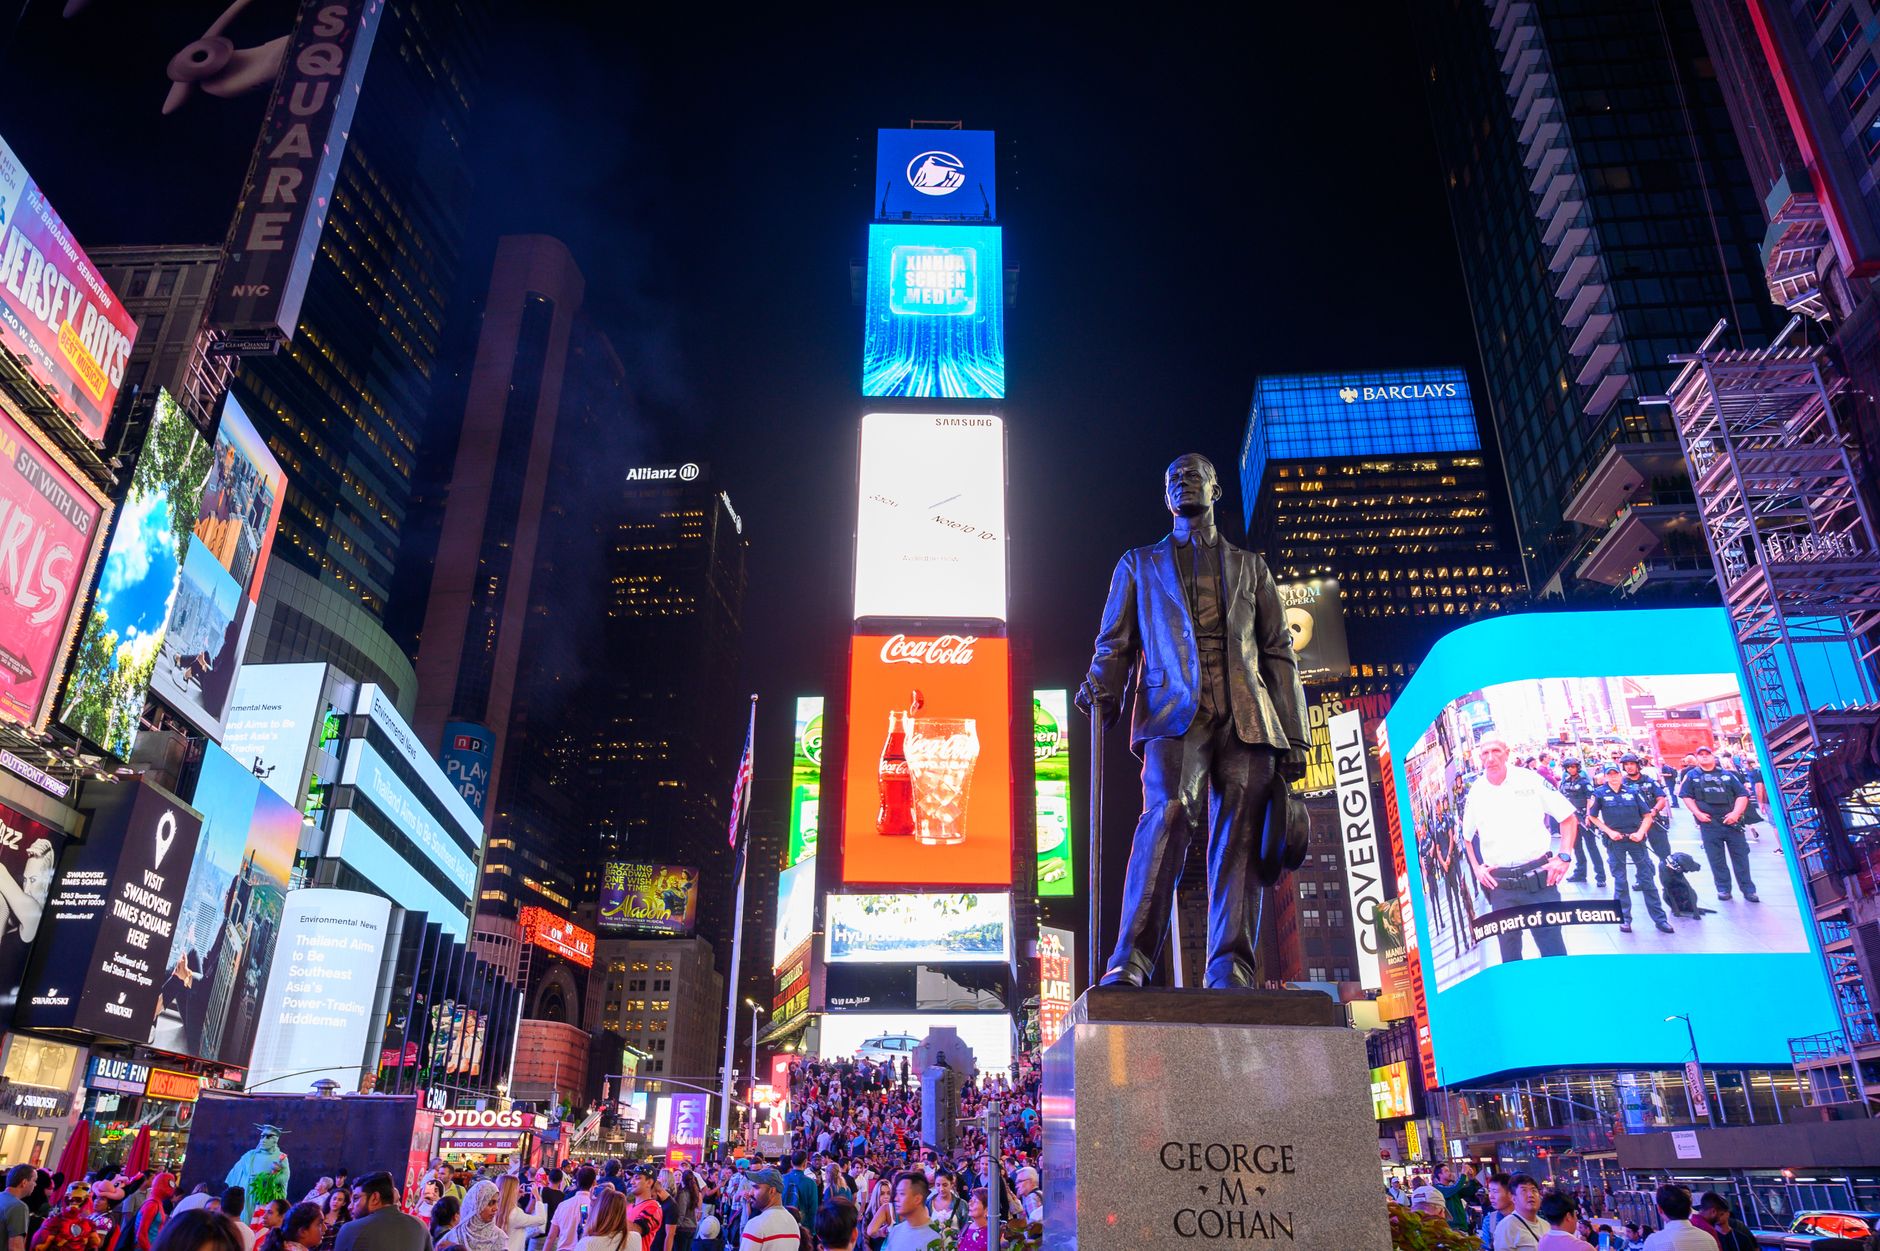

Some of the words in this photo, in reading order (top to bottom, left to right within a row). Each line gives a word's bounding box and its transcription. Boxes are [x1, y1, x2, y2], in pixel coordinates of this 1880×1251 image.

[245, 4, 348, 251] SQUARE
[27, 190, 44, 214] THE
[41, 211, 79, 263] BROADWAY
[76, 261, 112, 309] SENSATION
[905, 271, 966, 288] SCREEN
[231, 284, 271, 297] NYC
[904, 288, 966, 304] MEDIA
[0, 225, 84, 335] JERSEY
[79, 301, 132, 389] BOYS
[2, 307, 19, 329] 340
[18, 326, 28, 342] W.
[43, 357, 54, 372] ST.
[75, 355, 105, 393] MUSICAL
[1363, 383, 1456, 401] BARCLAYS
[935, 418, 992, 427] SAMSUNG
[626, 468, 677, 481] Allianz
[17, 452, 40, 479] SIT
[39, 470, 71, 516] WITH
[71, 507, 89, 534] US.
[373, 697, 406, 745] Environmental
[457, 738, 487, 753] npr
[372, 767, 403, 816] Thailand
[1336, 729, 1380, 955] COVERGIRL
[66, 871, 104, 879] SWAROVSKI
[605, 861, 653, 872] DAZZLING
[605, 869, 653, 878] BROADWAY
[61, 878, 81, 886] TIMES
[81, 878, 108, 886] SQUARE
[143, 869, 165, 892] VISIT
[604, 875, 625, 884] ONE
[627, 877, 652, 886] WISH
[123, 882, 172, 917] SWAROVSKI
[113, 899, 139, 924] TIMES
[138, 911, 172, 938] SQUARE
[300, 915, 358, 926] Environmental
[359, 920, 378, 931] News
[1473, 926, 1484, 941] You
[1483, 921, 1499, 938] are
[1499, 914, 1526, 935] part
[1526, 910, 1543, 927] of
[1545, 910, 1573, 925] our
[1575, 908, 1621, 923] team.
[126, 928, 150, 950] HERE
[295, 934, 348, 950] Thailand
[349, 938, 375, 953] Aims
[292, 950, 304, 962] to
[306, 949, 326, 962] Be
[102, 960, 112, 974] Red
[288, 965, 353, 981] Southeast
[284, 981, 323, 994] Asia's
[31, 997, 70, 1006] SWAROVSKI
[281, 996, 366, 1017] Power-Trading
[278, 1011, 348, 1029] Middleman
[97, 1057, 128, 1080] BLUE
[129, 1063, 149, 1083] FIN
[23, 1095, 57, 1109] SWAROVSKI
[677, 1098, 701, 1146] tkts
[1159, 1141, 1296, 1174] GEORGE
[1218, 1177, 1249, 1206] M
[1173, 1208, 1295, 1241] COHAN
